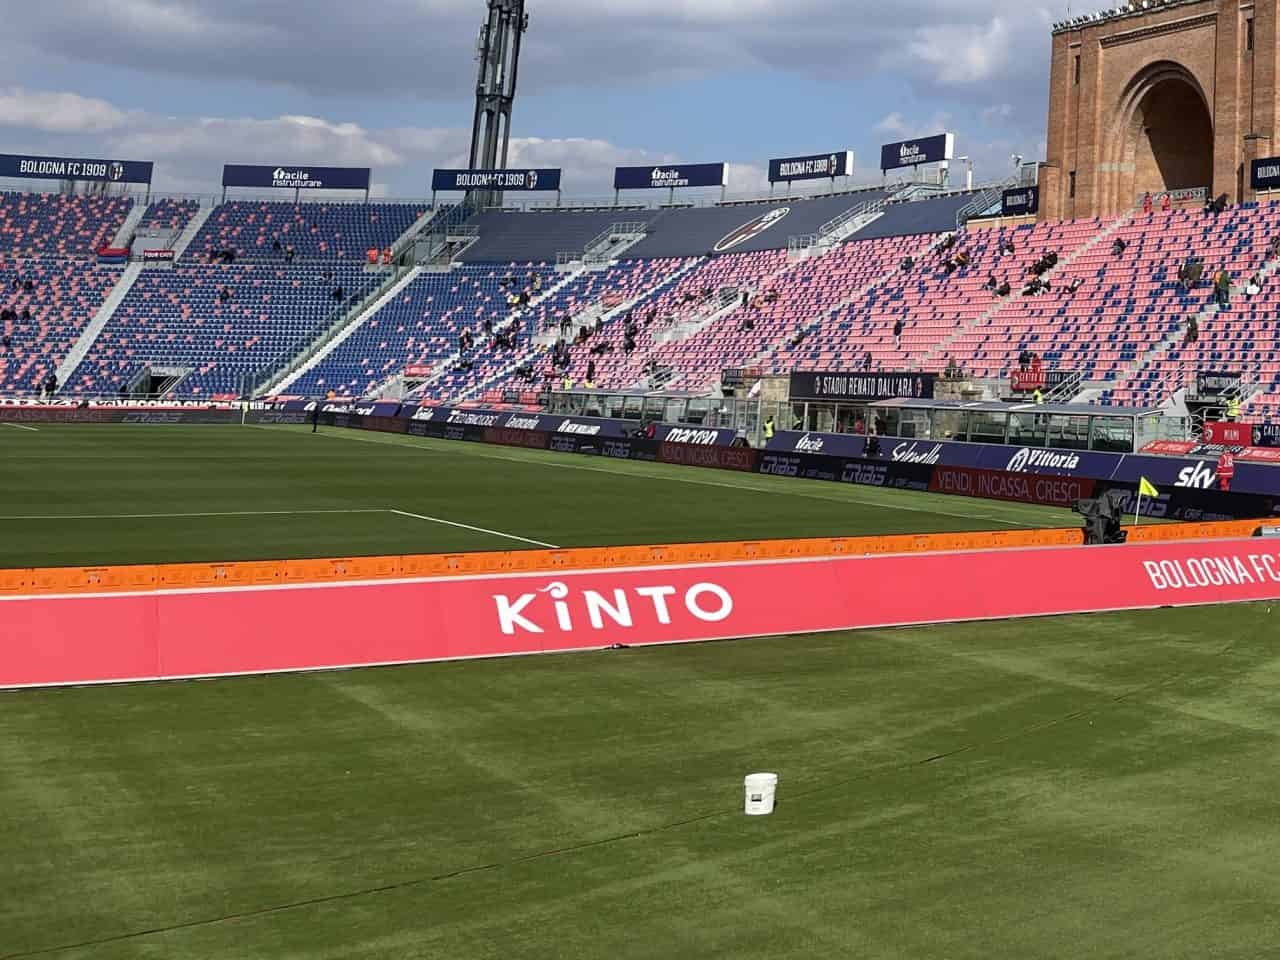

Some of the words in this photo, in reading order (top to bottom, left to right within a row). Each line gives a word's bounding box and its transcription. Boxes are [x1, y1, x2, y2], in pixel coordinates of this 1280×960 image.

[20, 160, 65, 175] BOLOGNA
[67, 163, 80, 176] FC
[82, 164, 106, 177] 1909
[780, 162, 804, 176] BOLOGNA
[805, 160, 813, 174] FC
[814, 159, 828, 172] 1909
[456, 174, 493, 186] BOLOGNA
[505, 174, 525, 186] 1909
[823, 377, 847, 394] STADIO
[849, 377, 876, 395] RENATO
[878, 378, 913, 396] DALL'ARA
[665, 428, 718, 445] macron
[1028, 450, 1080, 470] Vittoria
[1174, 460, 1217, 489] sky
[1035, 479, 1081, 502] CRESCI
[1143, 555, 1255, 590] BOLOGNA
